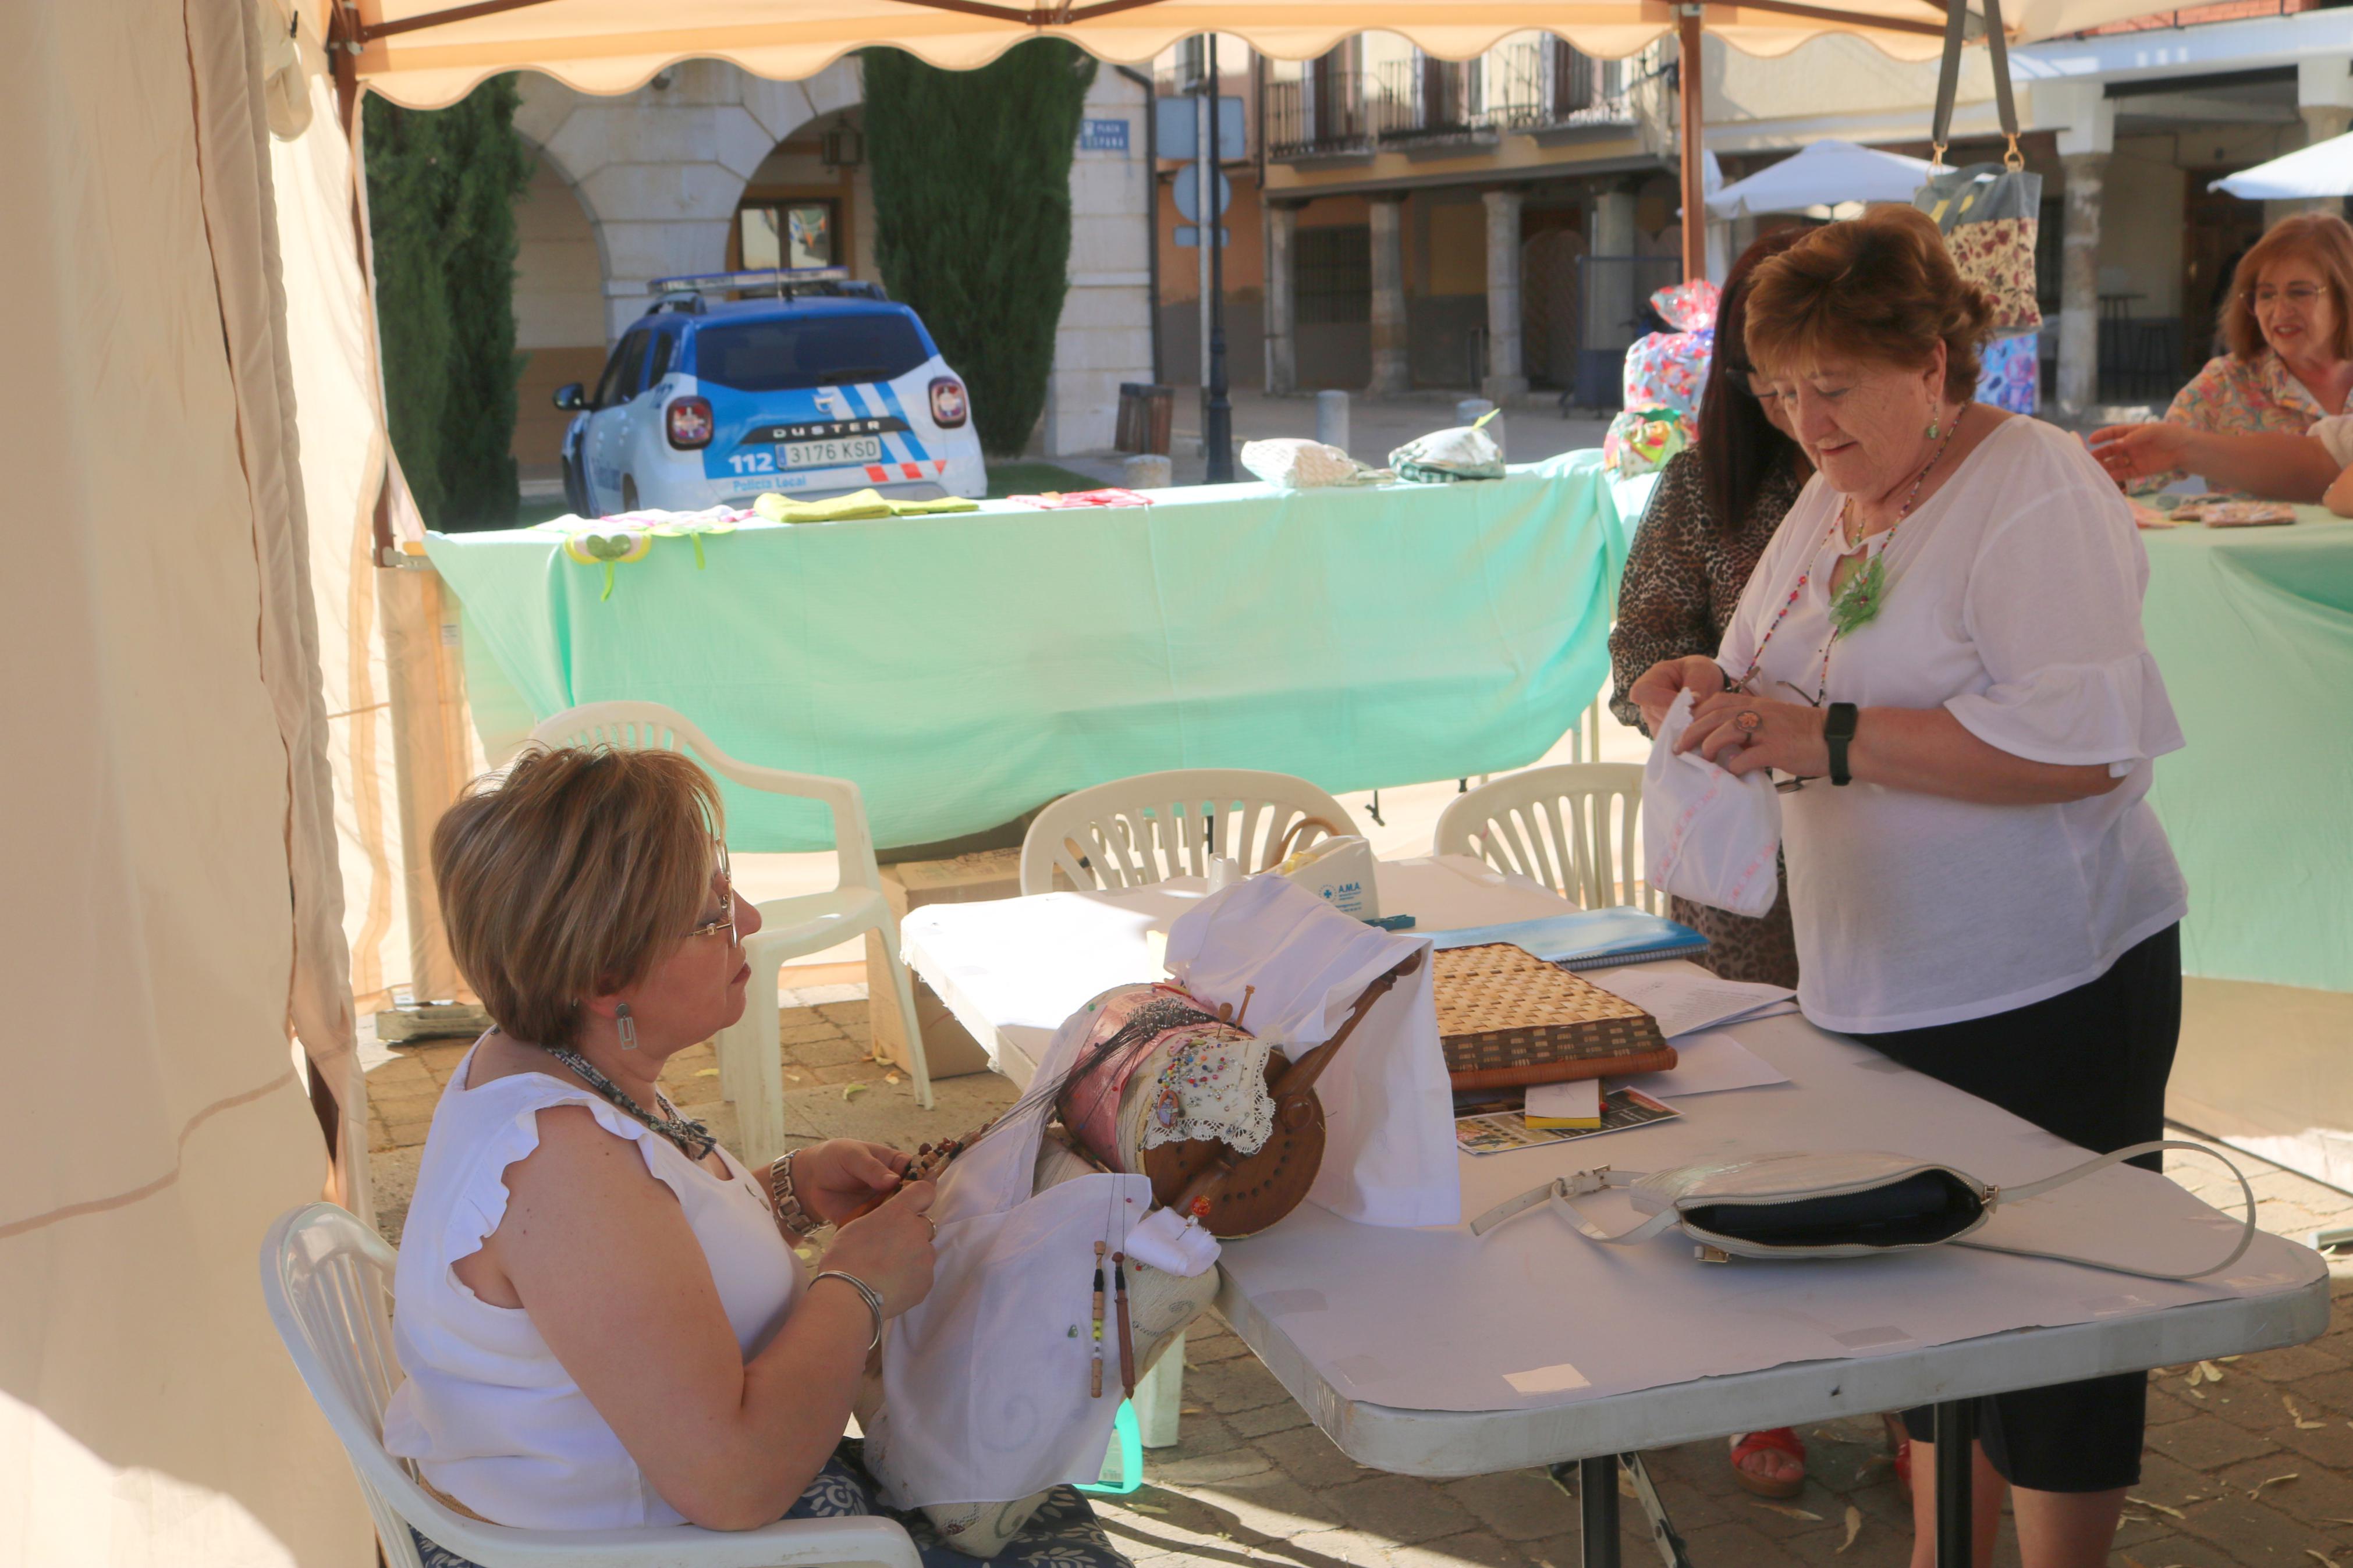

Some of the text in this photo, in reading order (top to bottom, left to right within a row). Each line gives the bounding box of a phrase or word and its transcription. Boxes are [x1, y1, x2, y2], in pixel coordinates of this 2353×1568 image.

[773, 420, 880, 438] DUSTER
[790, 445, 836, 463] 3176
[841, 440, 876, 458] KSD
[729, 452, 774, 474] 112
[776, 475, 807, 488] Local
